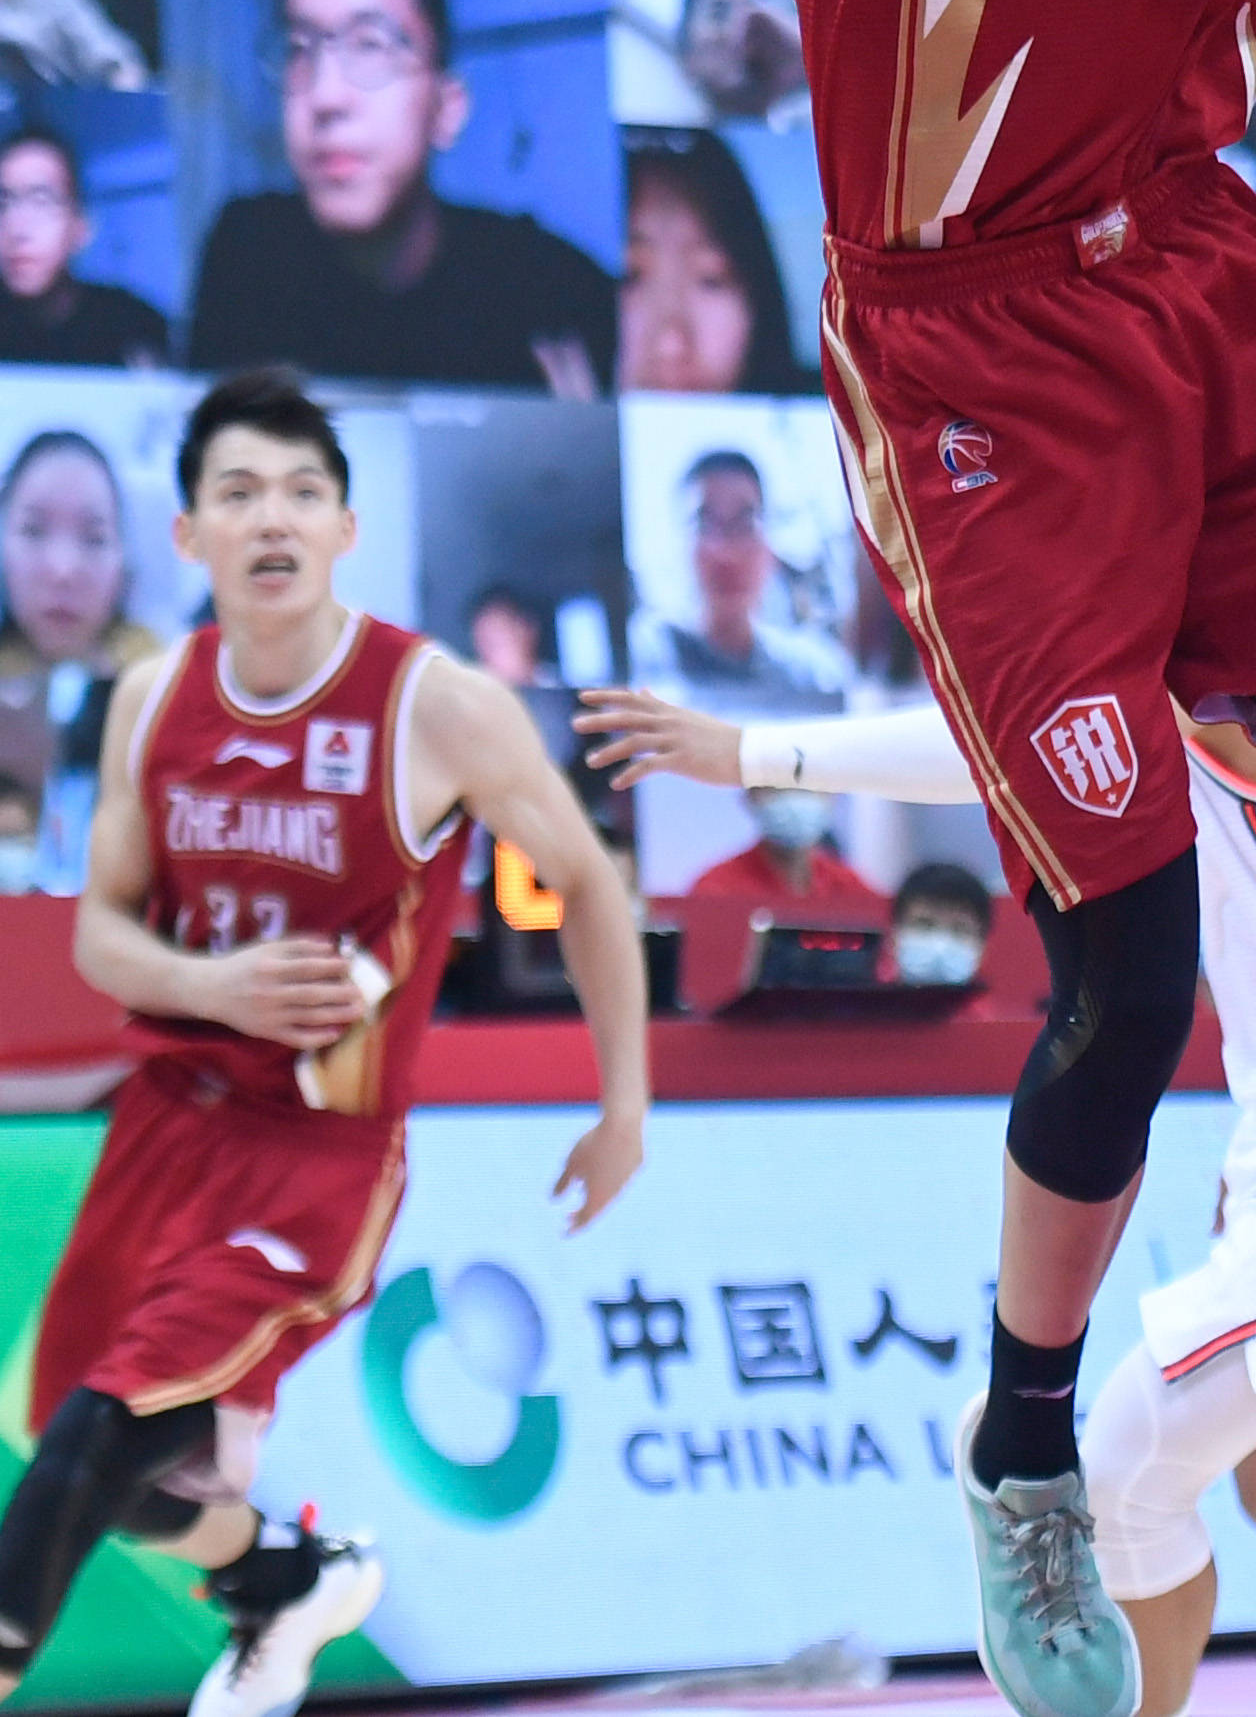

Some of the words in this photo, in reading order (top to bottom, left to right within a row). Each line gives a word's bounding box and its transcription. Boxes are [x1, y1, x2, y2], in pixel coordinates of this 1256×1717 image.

[165, 784, 342, 877] ZHEJIANG
[590, 1276, 998, 1402] 中国人
[622, 1420, 894, 1492] CHINA
